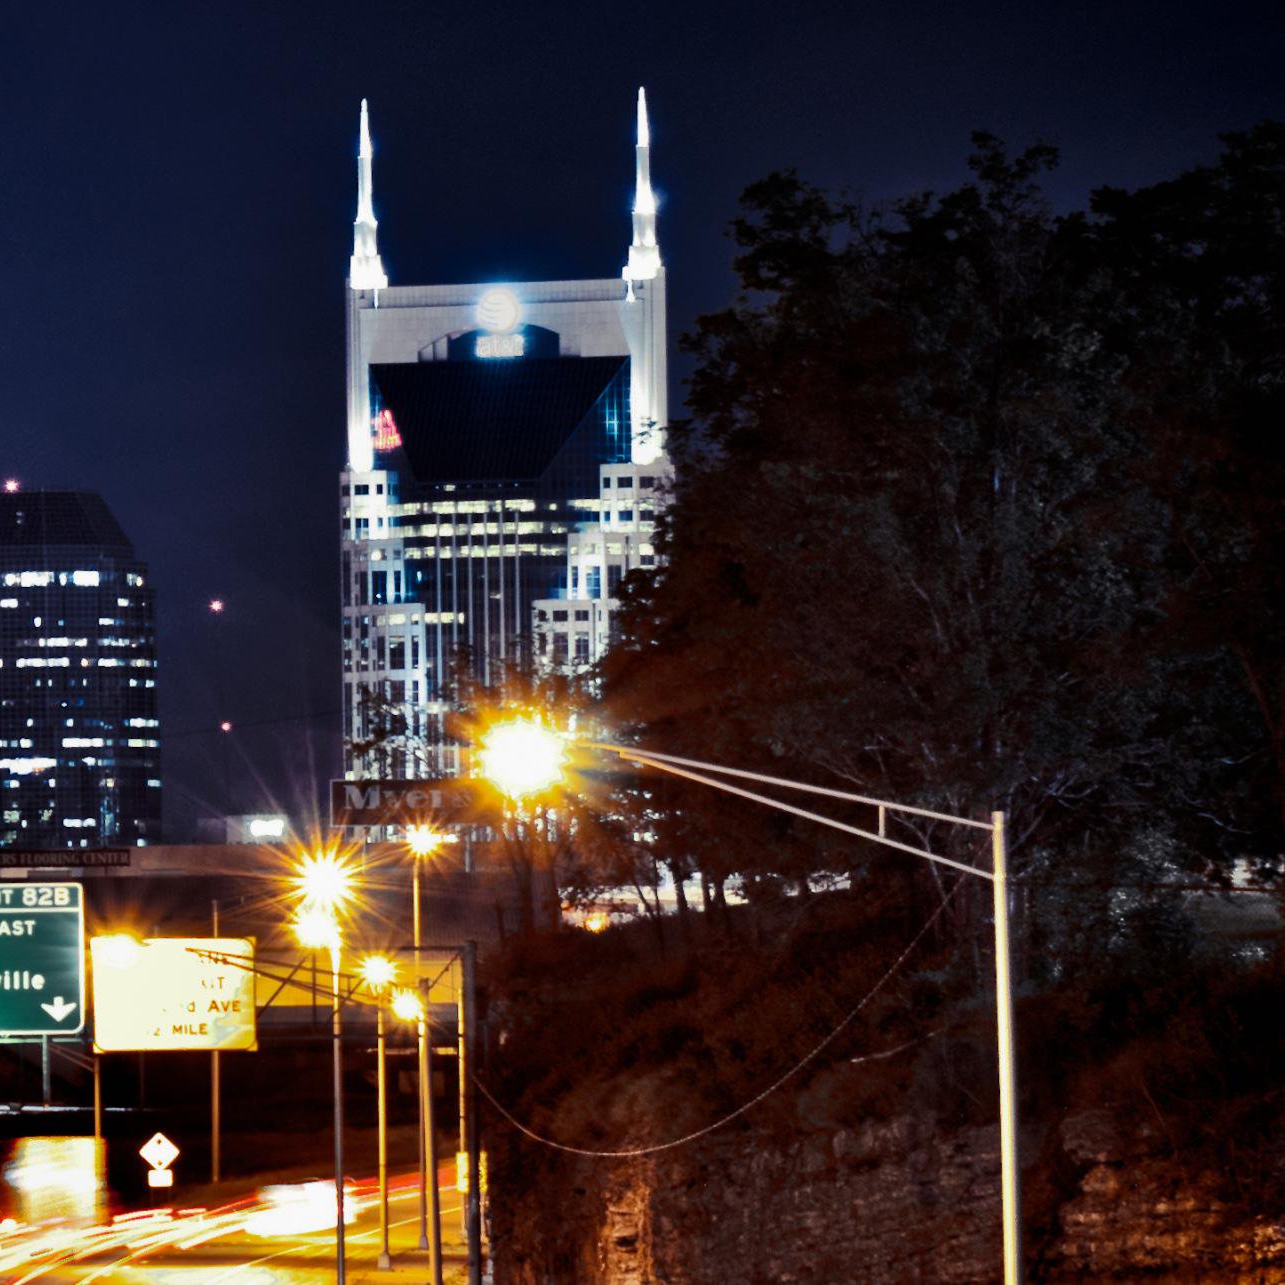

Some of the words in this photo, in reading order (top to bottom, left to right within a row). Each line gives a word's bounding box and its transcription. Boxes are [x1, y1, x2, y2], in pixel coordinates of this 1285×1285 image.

[82, 851, 129, 864] CENTER
[22, 887, 70, 906] 82B
[208, 1000, 241, 1012] AVE
[172, 1023, 208, 1035] MILE
